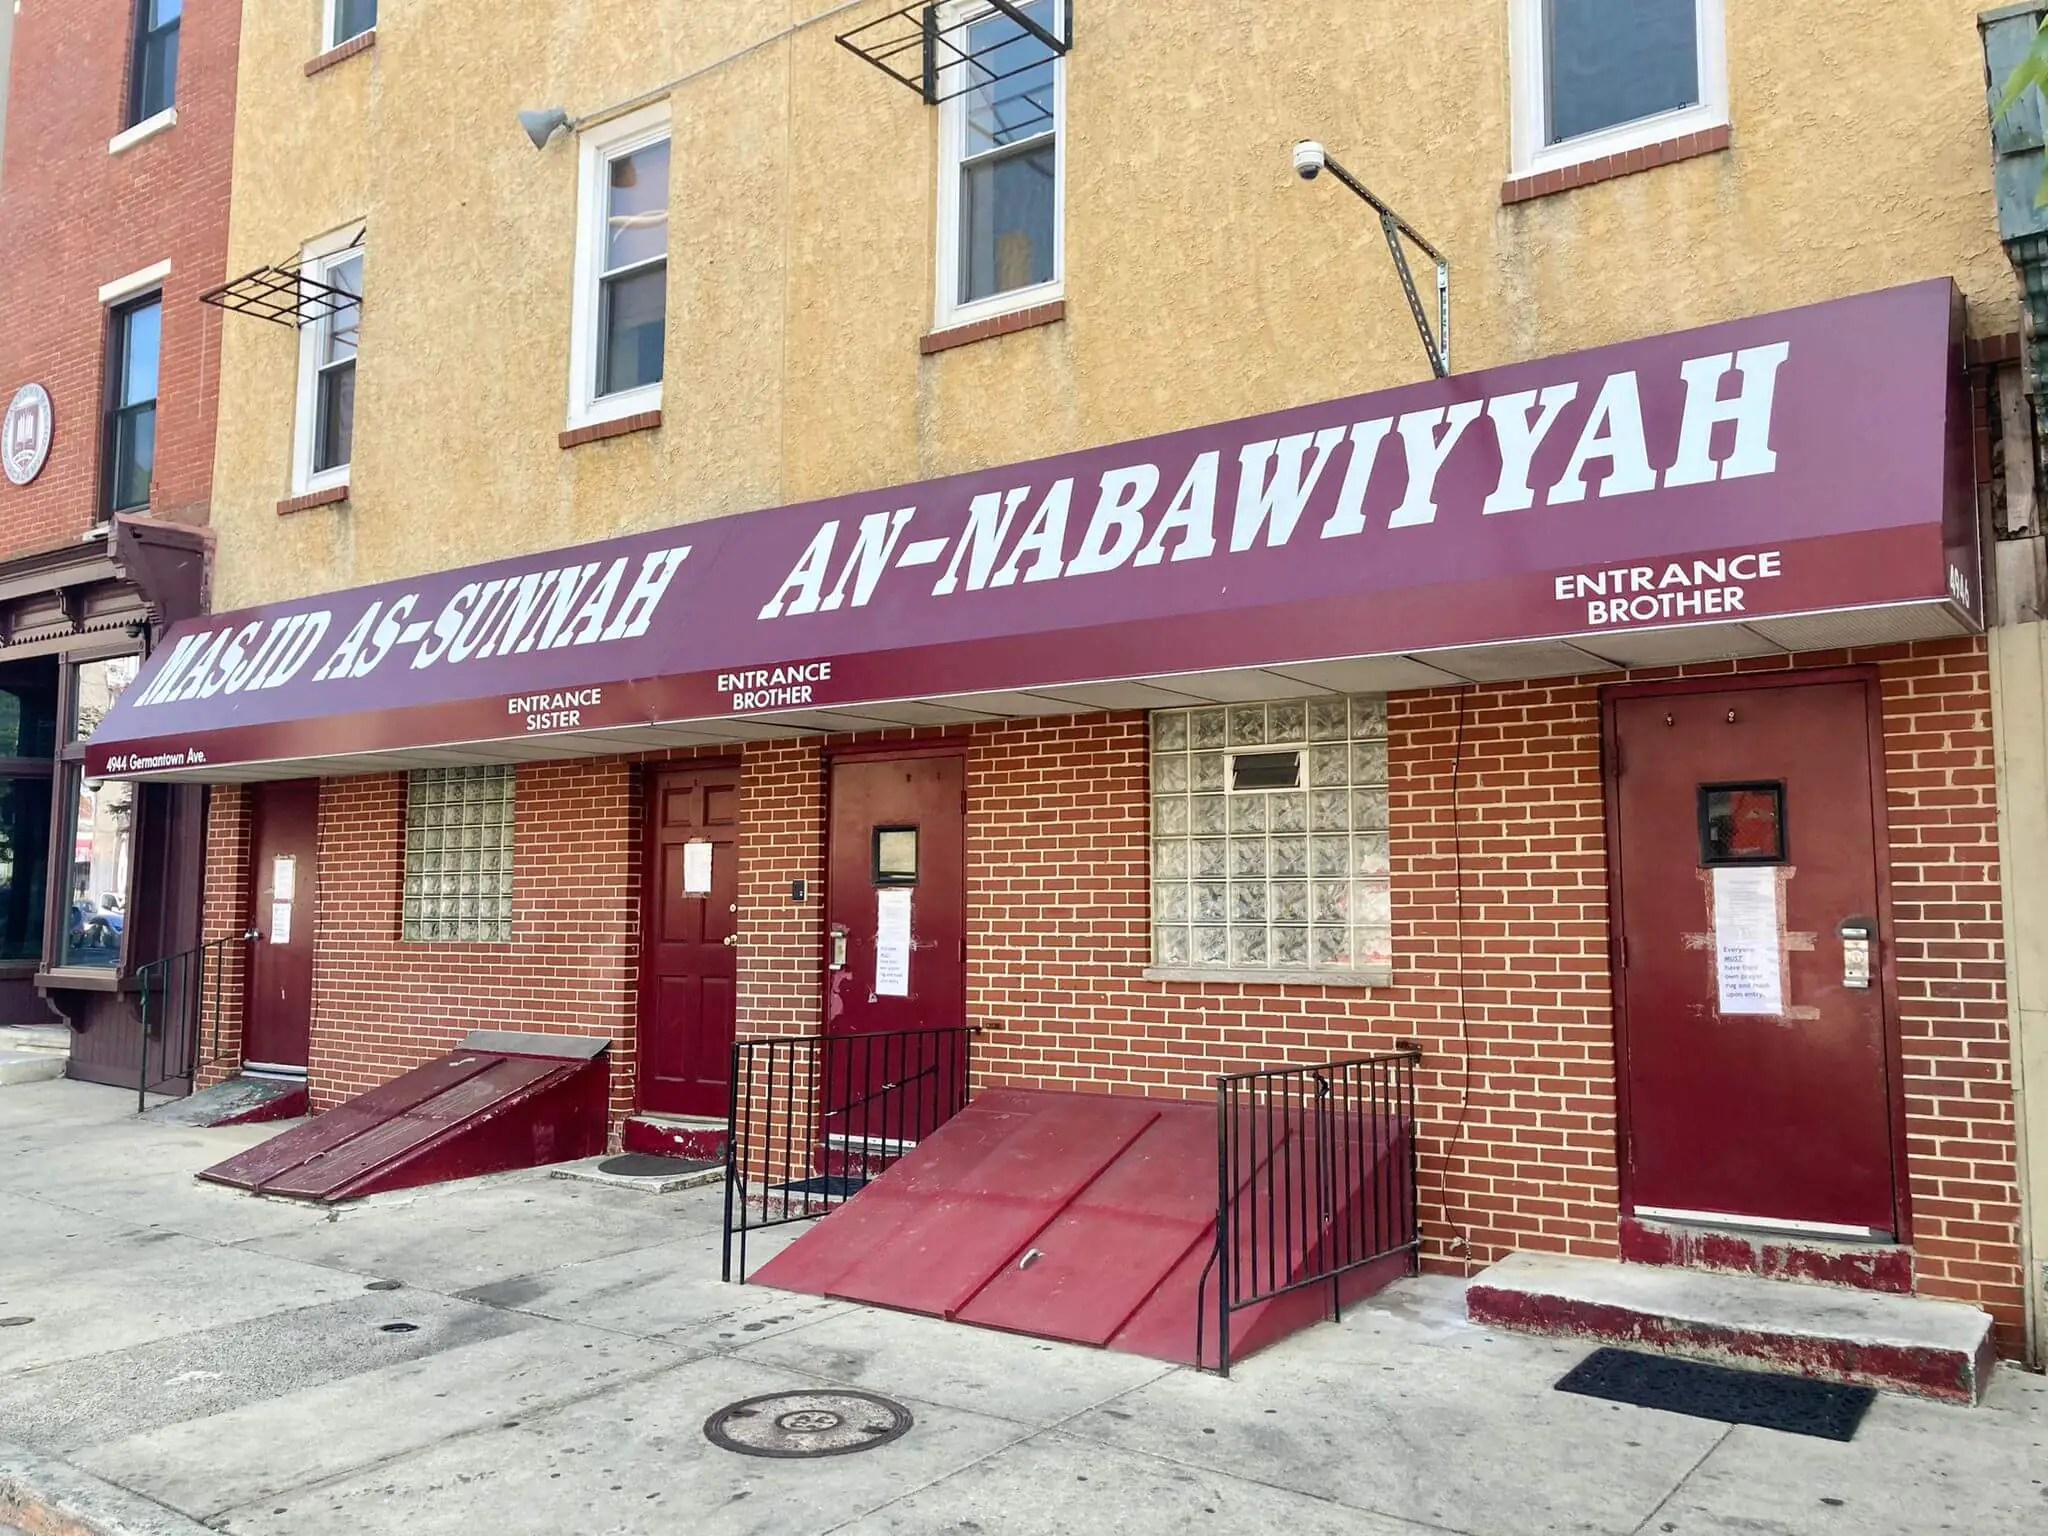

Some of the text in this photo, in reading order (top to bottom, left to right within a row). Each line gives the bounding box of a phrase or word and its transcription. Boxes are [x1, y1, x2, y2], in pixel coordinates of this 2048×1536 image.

[133, 341, 1791, 707] MASJID AS-SUNNAH AN-NABAWIYYAH
[1555, 551, 1781, 600] ENTRANCE
[1949, 563, 1970, 609] 4946
[1588, 586, 1745, 625] BROTHER
[717, 662, 832, 692] ENTRANCE
[508, 688, 602, 714] ENTRANCE
[733, 685, 812, 711] BROTHER
[526, 710, 580, 731] SISTER
[106, 747, 206, 772] 4944 Germantown Ave.
